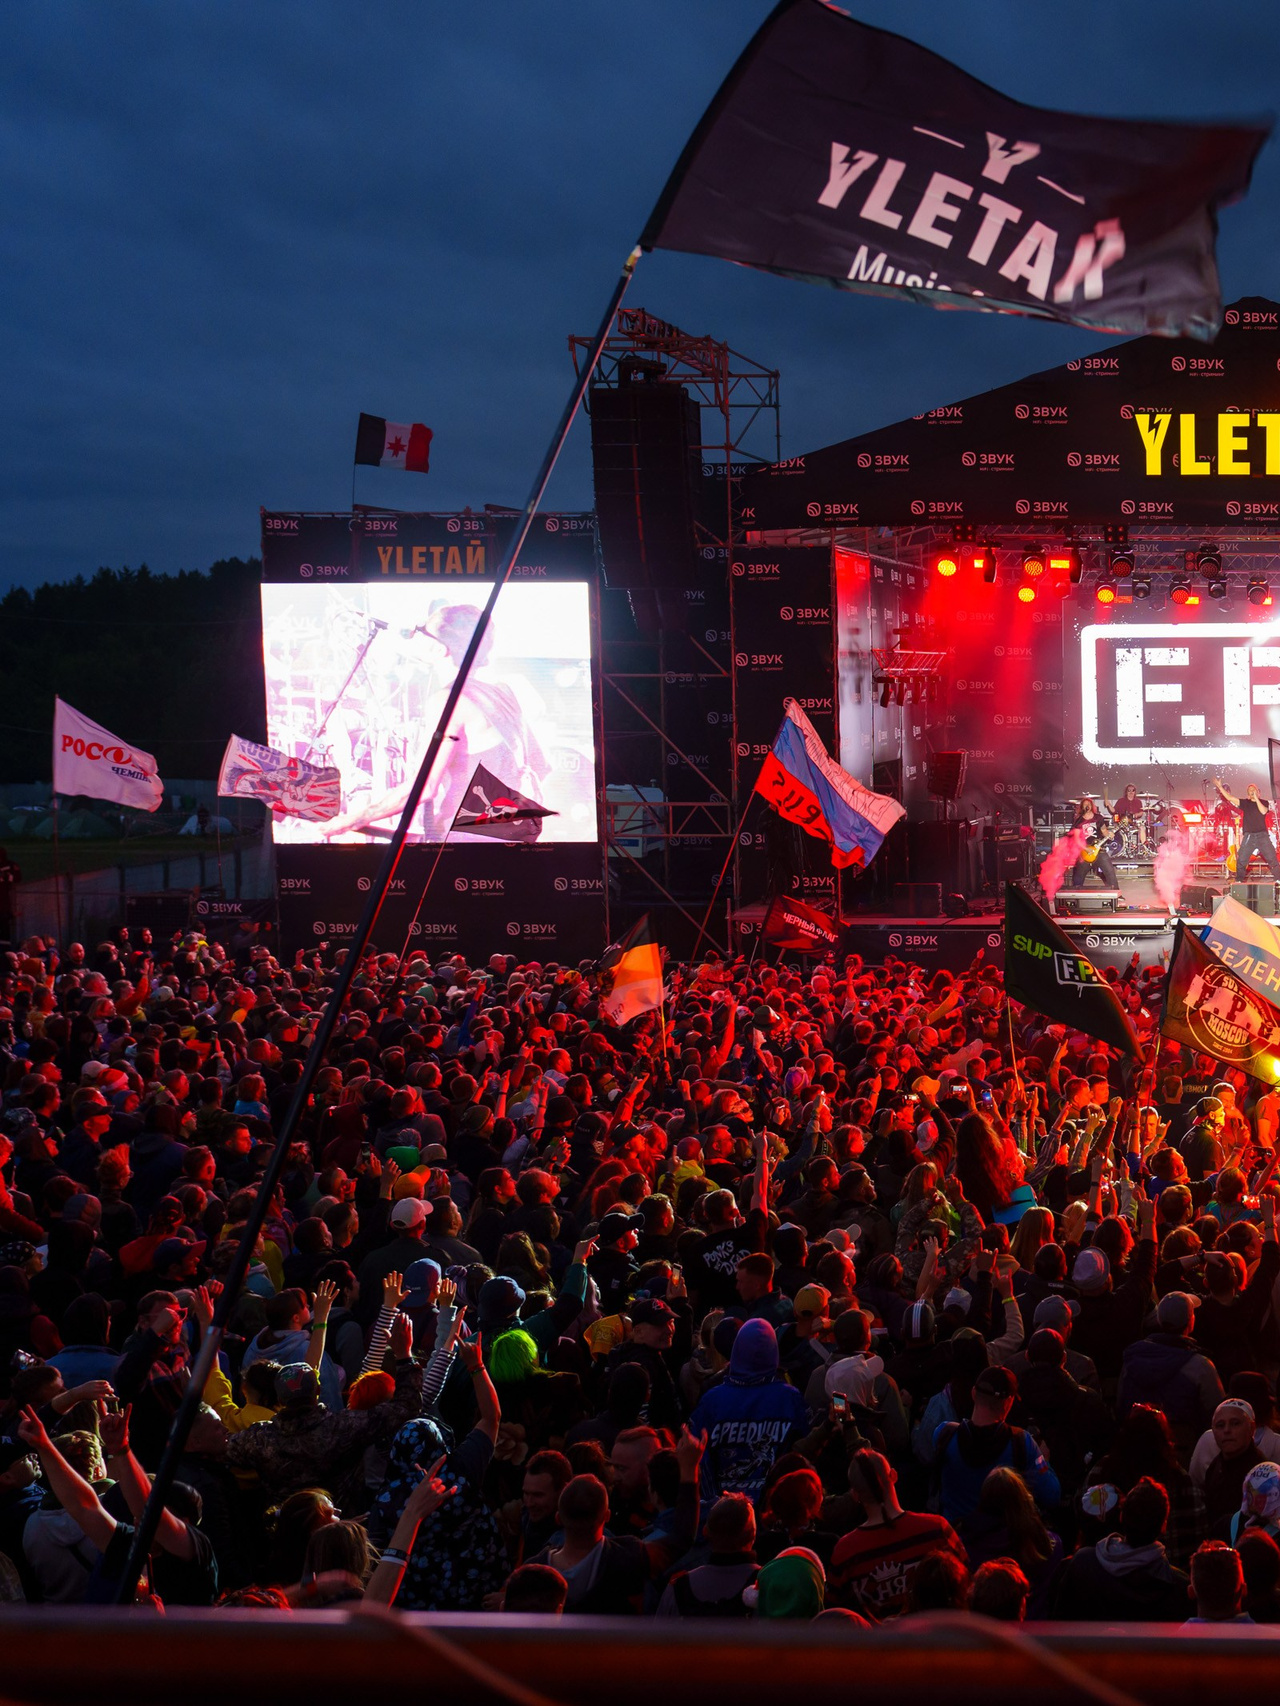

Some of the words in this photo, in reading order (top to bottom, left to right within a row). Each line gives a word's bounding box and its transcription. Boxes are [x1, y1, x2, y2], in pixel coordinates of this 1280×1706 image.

[847, 244, 952, 291] Musi
[1243, 313, 1277, 323] ЗВУК
[1085, 359, 1119, 368] ЗВУК
[1190, 359, 1224, 369] ЗВУК
[929, 407, 962, 418] ЗВУК
[1033, 407, 1067, 417] ЗВУК
[875, 455, 909, 465] ЗВУК
[980, 454, 1014, 464] ЗВУК
[1085, 455, 1119, 464] ЗВУК
[825, 504, 858, 514] ЗВУК
[929, 502, 963, 512] ЗВУК
[1034, 502, 1068, 511] ЗВУК
[1139, 502, 1173, 512] ЗВУК
[1245, 504, 1278, 513] ЗВУК
[266, 519, 298, 529] ЗВУК
[366, 521, 397, 530] ЗВУК
[563, 520, 595, 529] ЗВУК
[317, 566, 349, 575] ЗВУК
[514, 566, 546, 576] ЗВУК
[748, 564, 780, 574] ЗВУК
[797, 609, 829, 618] ЗВУК
[752, 655, 783, 664] ЗВУК
[800, 698, 831, 708] ЗВУК
[1046, 751, 1063, 759] ЗВУ
[1007, 783, 1032, 792] ЗВУК
[281, 879, 310, 888] ЗВУК
[472, 880, 504, 889] ЗВУК
[571, 880, 603, 888] ЗВУК
[425, 924, 457, 933] ЗВУК
[524, 924, 556, 933] ЗВУК
[906, 936, 937, 945] ЗВУК
[1103, 936, 1135, 946] ЗВУК
[1207, 1014, 1250, 1044] MOSCOW
[711, 1420, 793, 1448] SPEEDWAY
